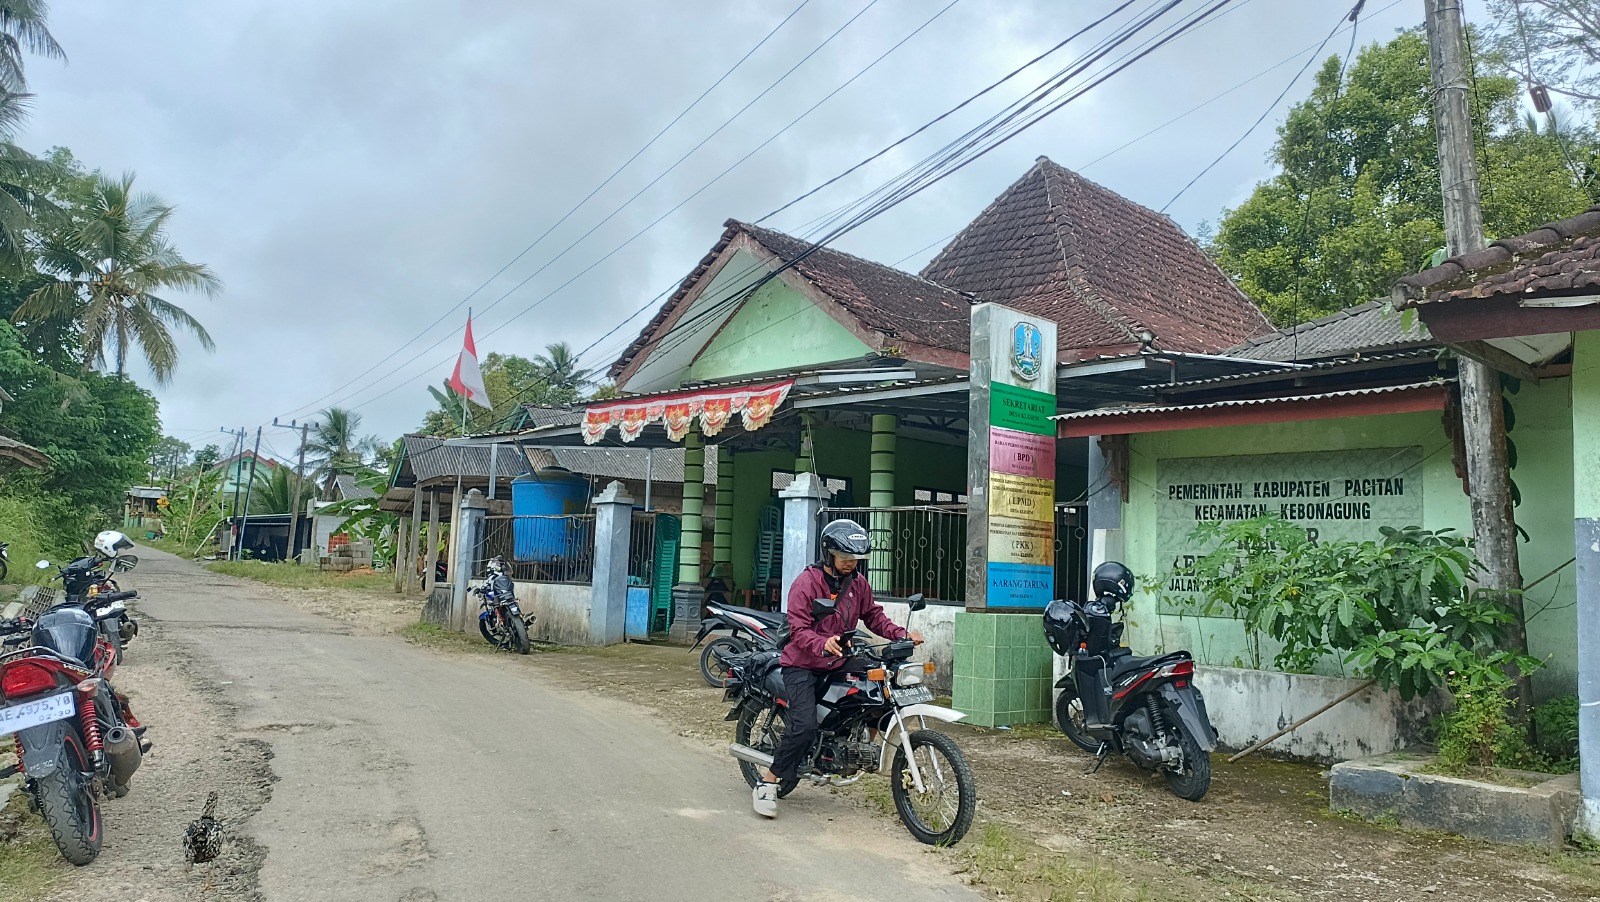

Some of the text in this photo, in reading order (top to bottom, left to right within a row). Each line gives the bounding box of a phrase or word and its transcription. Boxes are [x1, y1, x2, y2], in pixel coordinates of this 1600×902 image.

[1002, 398, 1045, 414] SEKRETARIAT
[1168, 478, 1404, 500] PEMERINTAH KABUPATEN PACITAN
[1194, 502, 1371, 520] KECAMATAN KEBONAGUNG
[993, 579, 1049, 589] KARANG TARUNA
